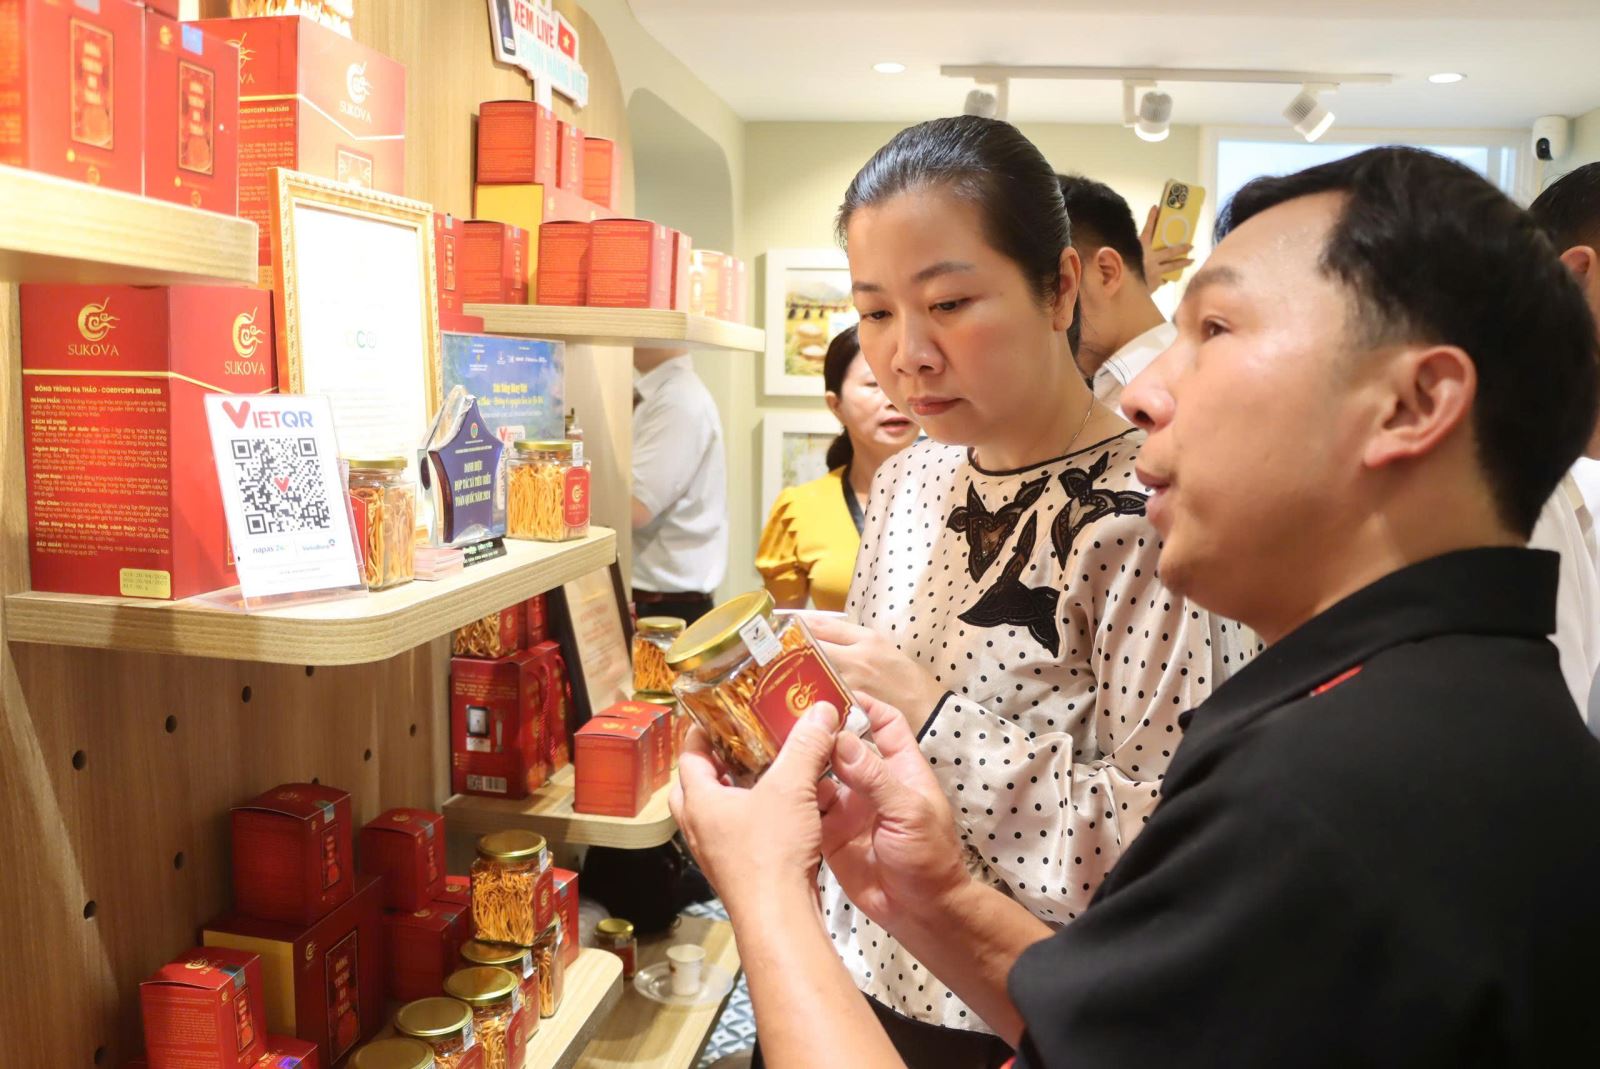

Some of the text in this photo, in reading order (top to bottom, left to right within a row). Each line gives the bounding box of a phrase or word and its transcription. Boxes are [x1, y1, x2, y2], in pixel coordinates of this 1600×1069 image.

[514, 1, 555, 49] XEM LIVE
[340, 101, 372, 124] SUKOVA
[67, 344, 120, 357] SUKOVA
[224, 360, 266, 377] SUKOVA
[222, 401, 314, 429] VIETQR
[252, 545, 274, 555] napas
